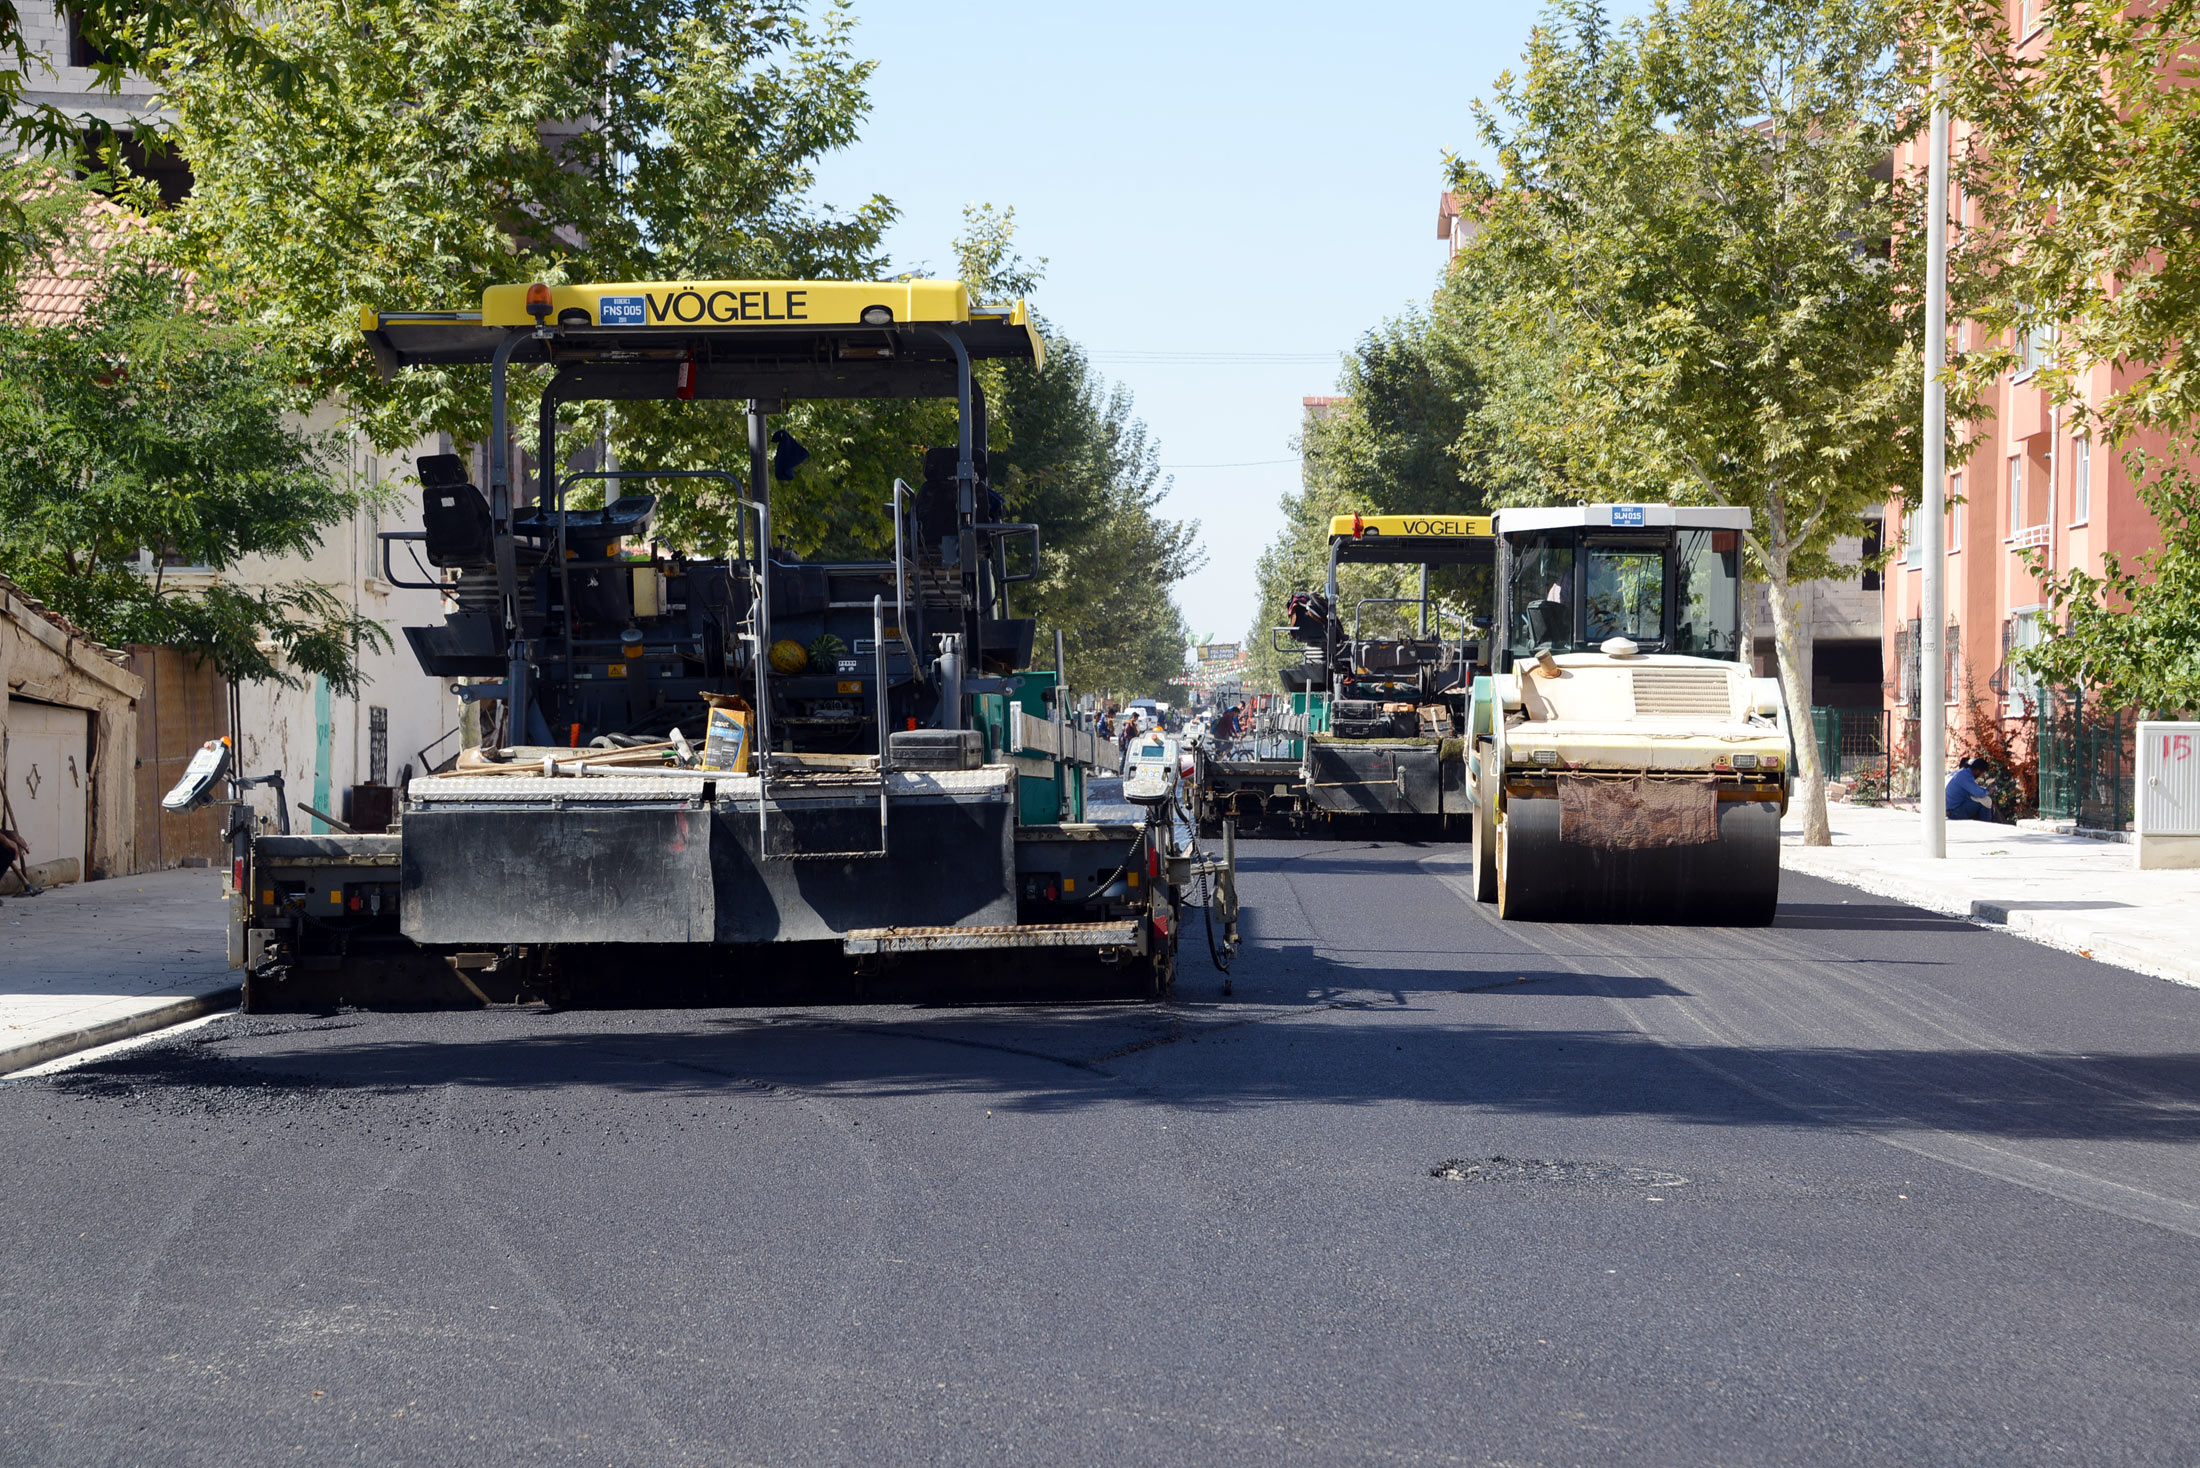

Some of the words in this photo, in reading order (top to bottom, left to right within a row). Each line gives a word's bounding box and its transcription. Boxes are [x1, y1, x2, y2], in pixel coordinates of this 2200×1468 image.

[603, 305, 622, 316] FNS
[623, 305, 642, 316] 005
[645, 286, 808, 323] VÖGELE
[1613, 512, 1628, 520] SLN
[1628, 512, 1642, 520] 015
[1403, 518, 1476, 535] VÖGELE
[2163, 734, 2192, 762] 15
